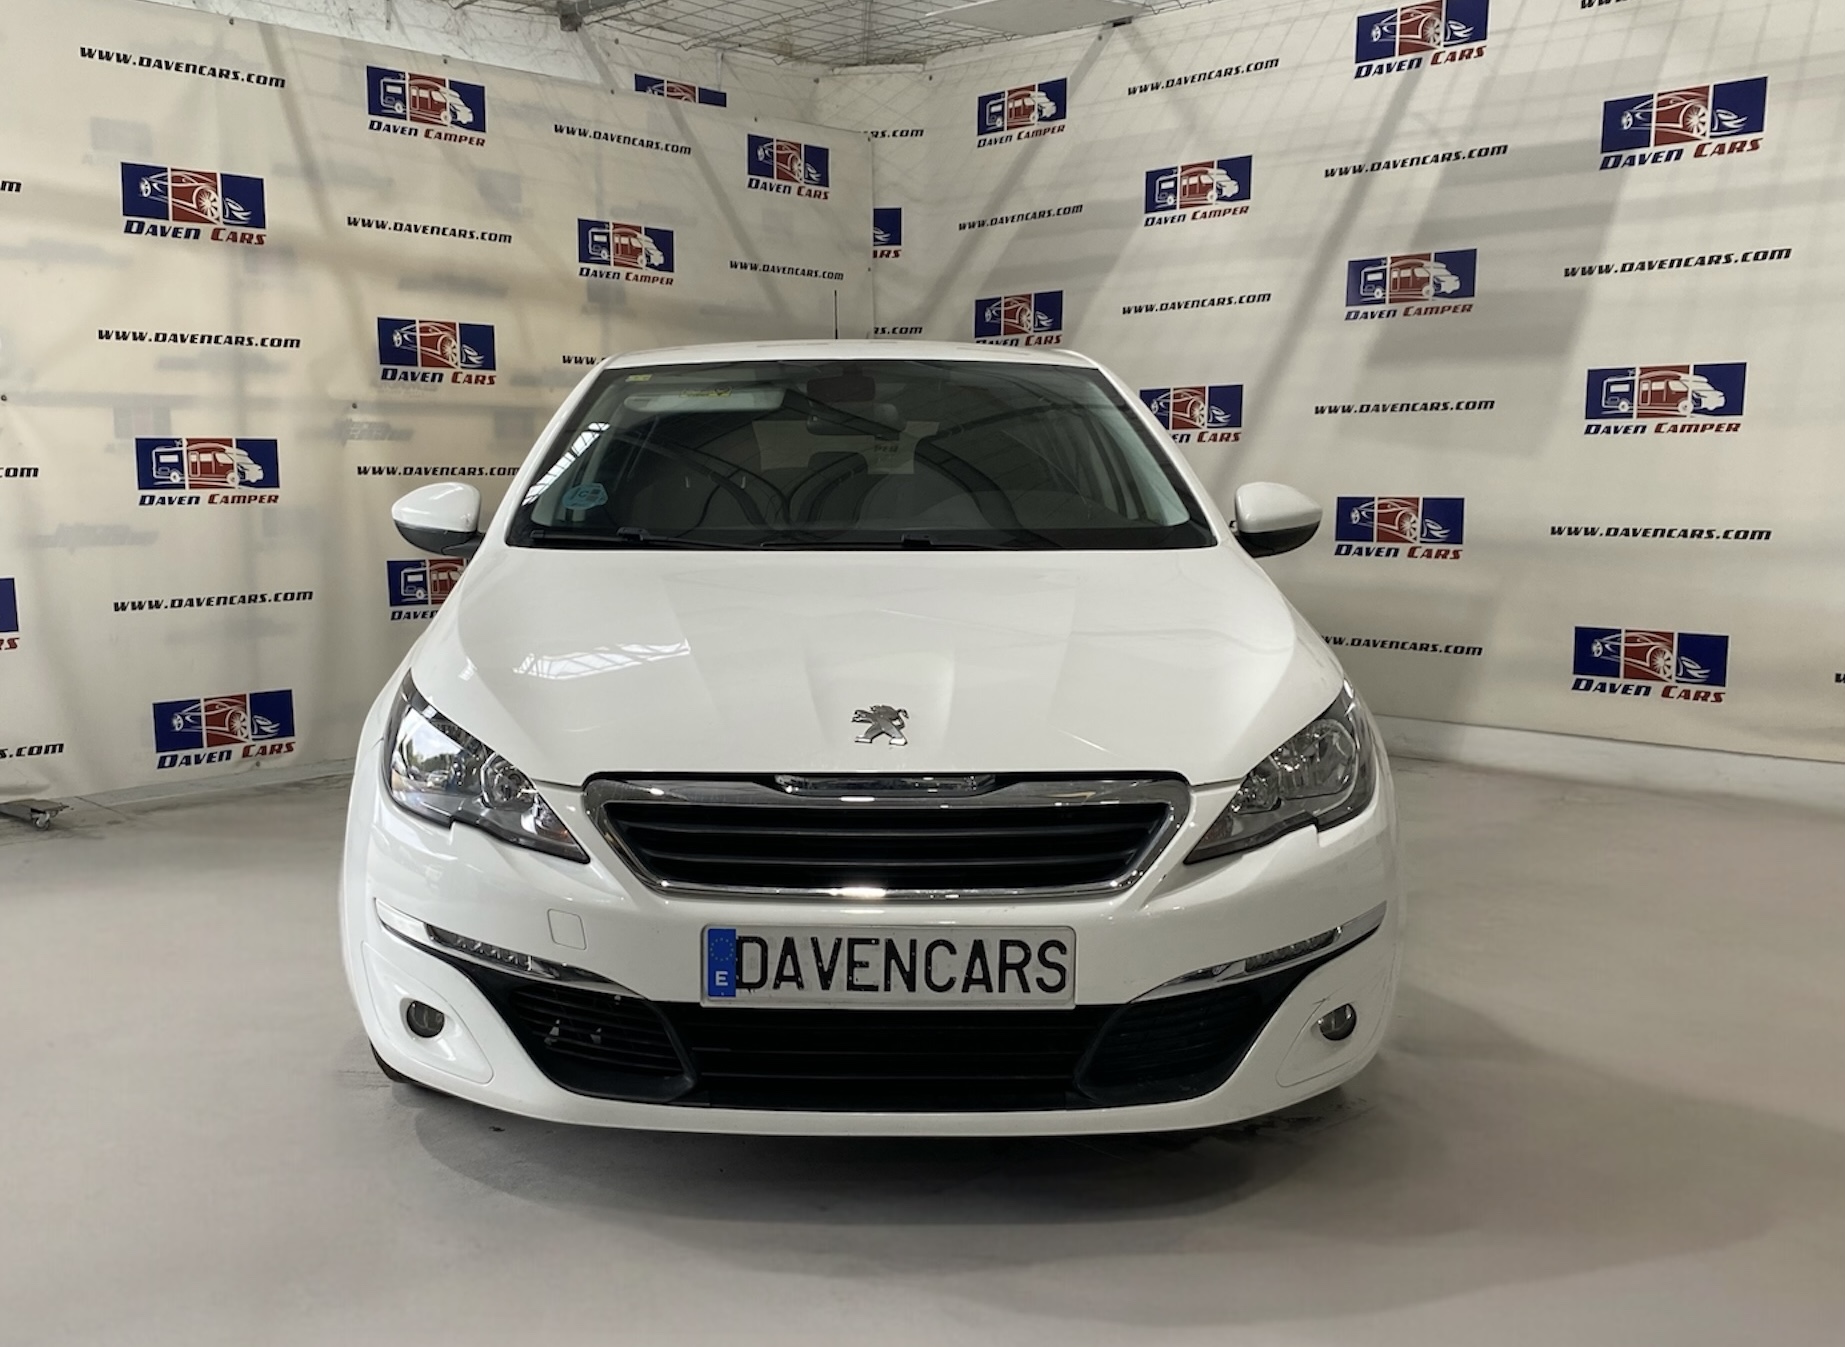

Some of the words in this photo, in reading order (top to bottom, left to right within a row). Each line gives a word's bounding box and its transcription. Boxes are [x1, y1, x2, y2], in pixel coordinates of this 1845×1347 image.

[1354, 57, 1423, 79] DAVEN
[1429, 45, 1486, 65] CARS
[369, 120, 418, 137] DAVEN
[424, 129, 485, 146] CAMPER
[977, 135, 1012, 148] DAVEN
[1017, 125, 1066, 141] CAMPER
[1600, 147, 1683, 170] DAVEN
[1692, 136, 1763, 158] CARS
[747, 178, 792, 195] DAVEN
[797, 186, 829, 200] CARS
[1144, 214, 1186, 227] DAVEN
[1191, 206, 1249, 220] CAMPER
[124, 220, 201, 240] DAVEN
[211, 228, 266, 245] CARS
[579, 267, 620, 280] DAVEN
[625, 272, 673, 285] CAMPER
[1345, 309, 1398, 320] DAVEN
[1403, 304, 1473, 316] CAMPER
[1025, 334, 1062, 346] CARS
[381, 368, 444, 383] DAVEN
[451, 371, 496, 385] CARS
[1197, 431, 1242, 442] CARS
[1584, 424, 1647, 435] DAVEN
[1654, 422, 1741, 433] CAMPER
[139, 495, 200, 506] DAVEN
[208, 494, 279, 504] CAMPER
[1334, 544, 1400, 557] DAVEN
[1407, 546, 1463, 559] CARS
[1571, 678, 1652, 696] DAVEN
[1661, 685, 1726, 703] CARS
[157, 750, 232, 769] DAVEN
[242, 742, 296, 760] CARS
[736, 936, 1067, 994] DAVENCARS
[716, 972, 727, 985] E
